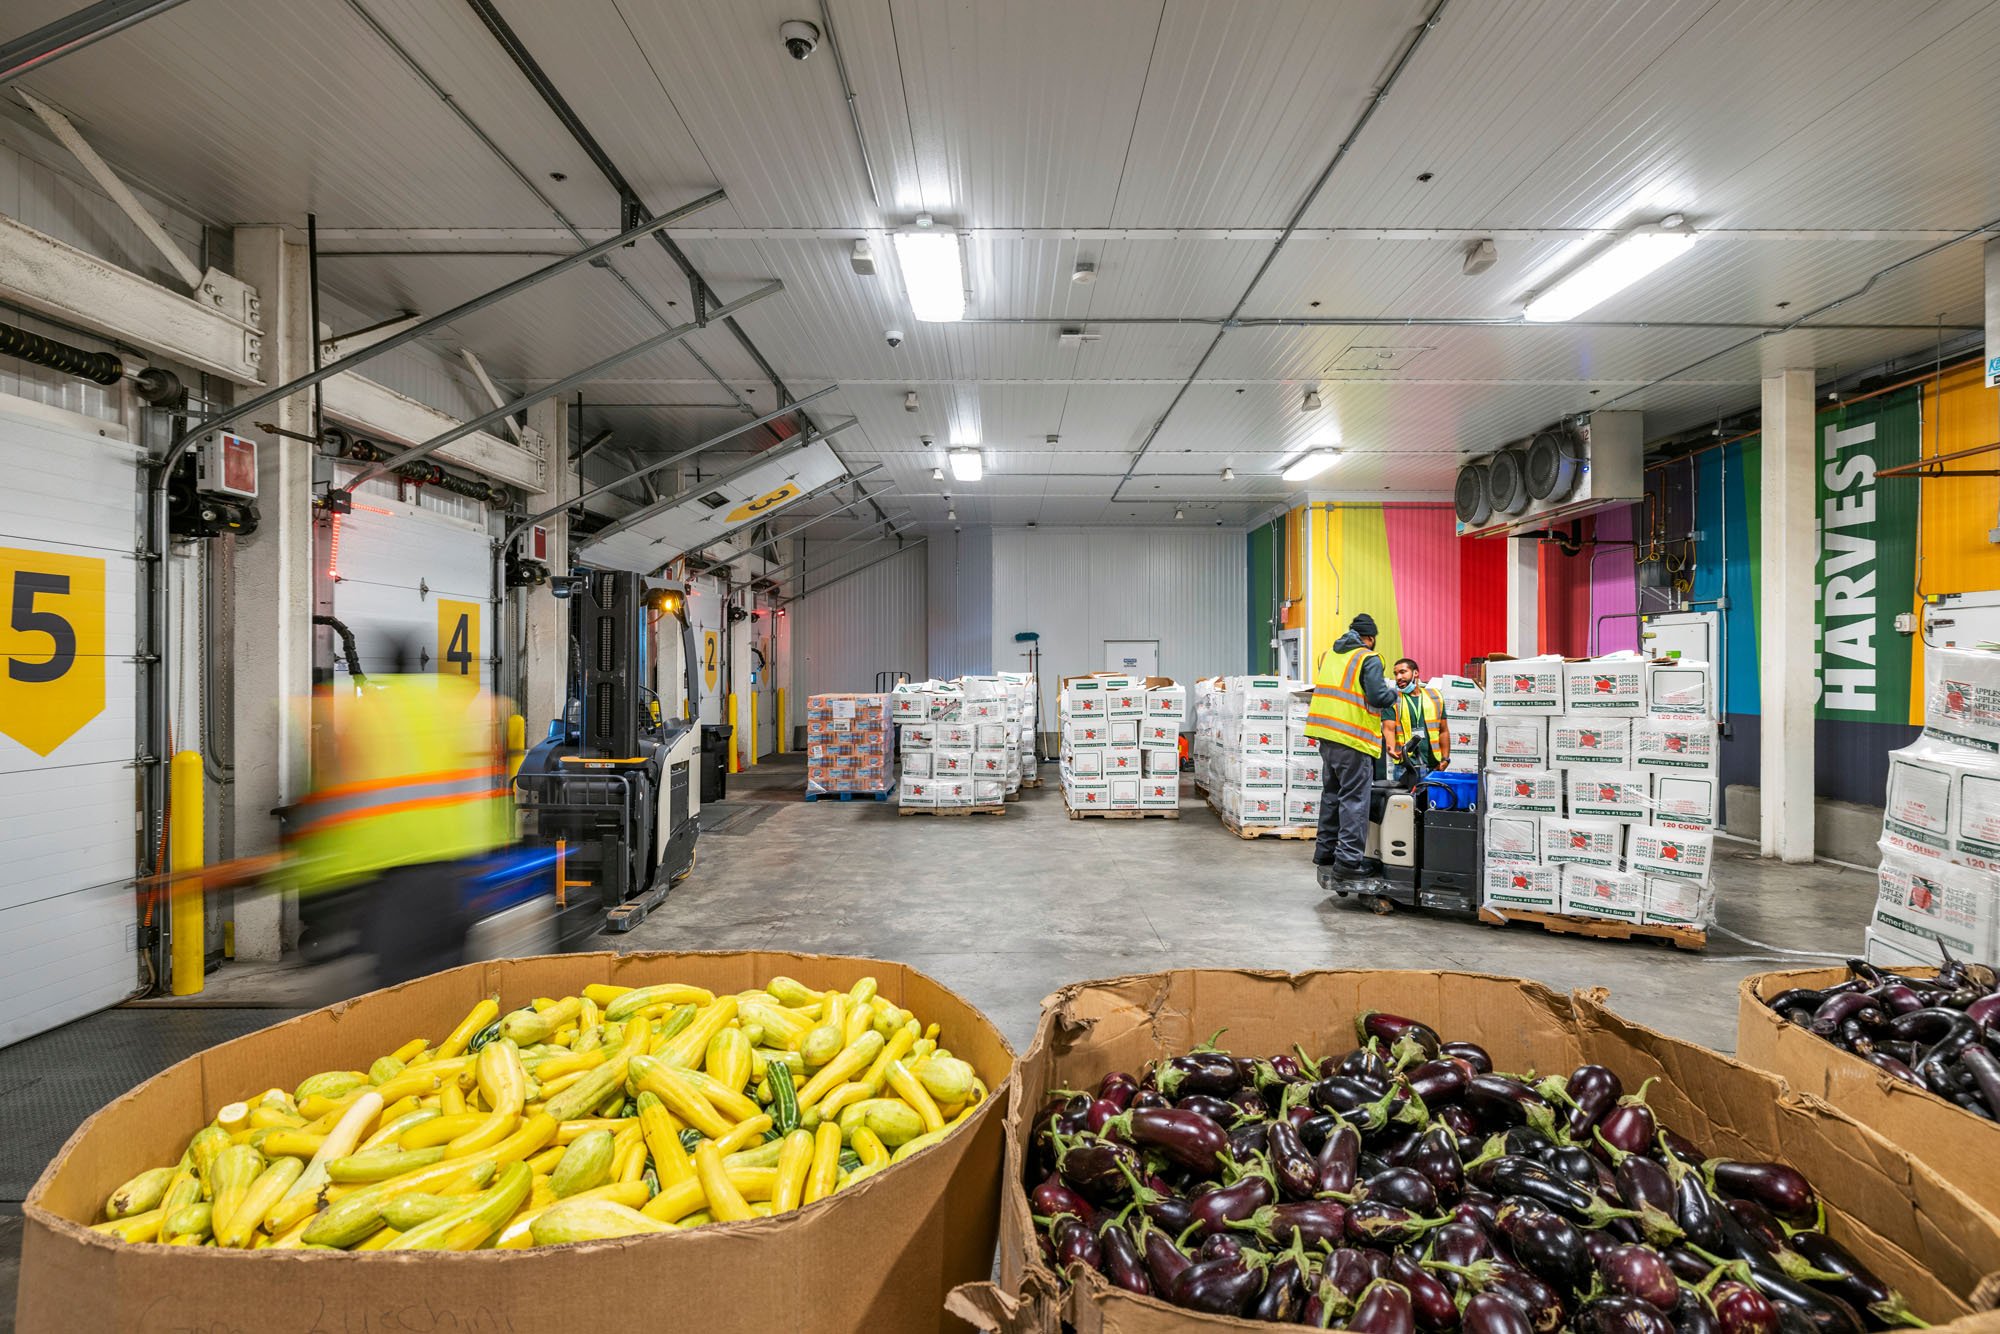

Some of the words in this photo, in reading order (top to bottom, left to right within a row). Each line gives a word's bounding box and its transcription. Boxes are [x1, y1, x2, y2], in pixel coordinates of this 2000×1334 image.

[748, 490, 790, 510] 3
[1824, 421, 1876, 711] HARVEST
[8, 571, 76, 683] 5
[446, 614, 472, 675] 4
[708, 638, 714, 671] 2
[1964, 737, 1993, 750] Snack
[1966, 857, 1985, 869] 120
[1572, 903, 1604, 912] America's
[1880, 914, 1923, 935] America's
